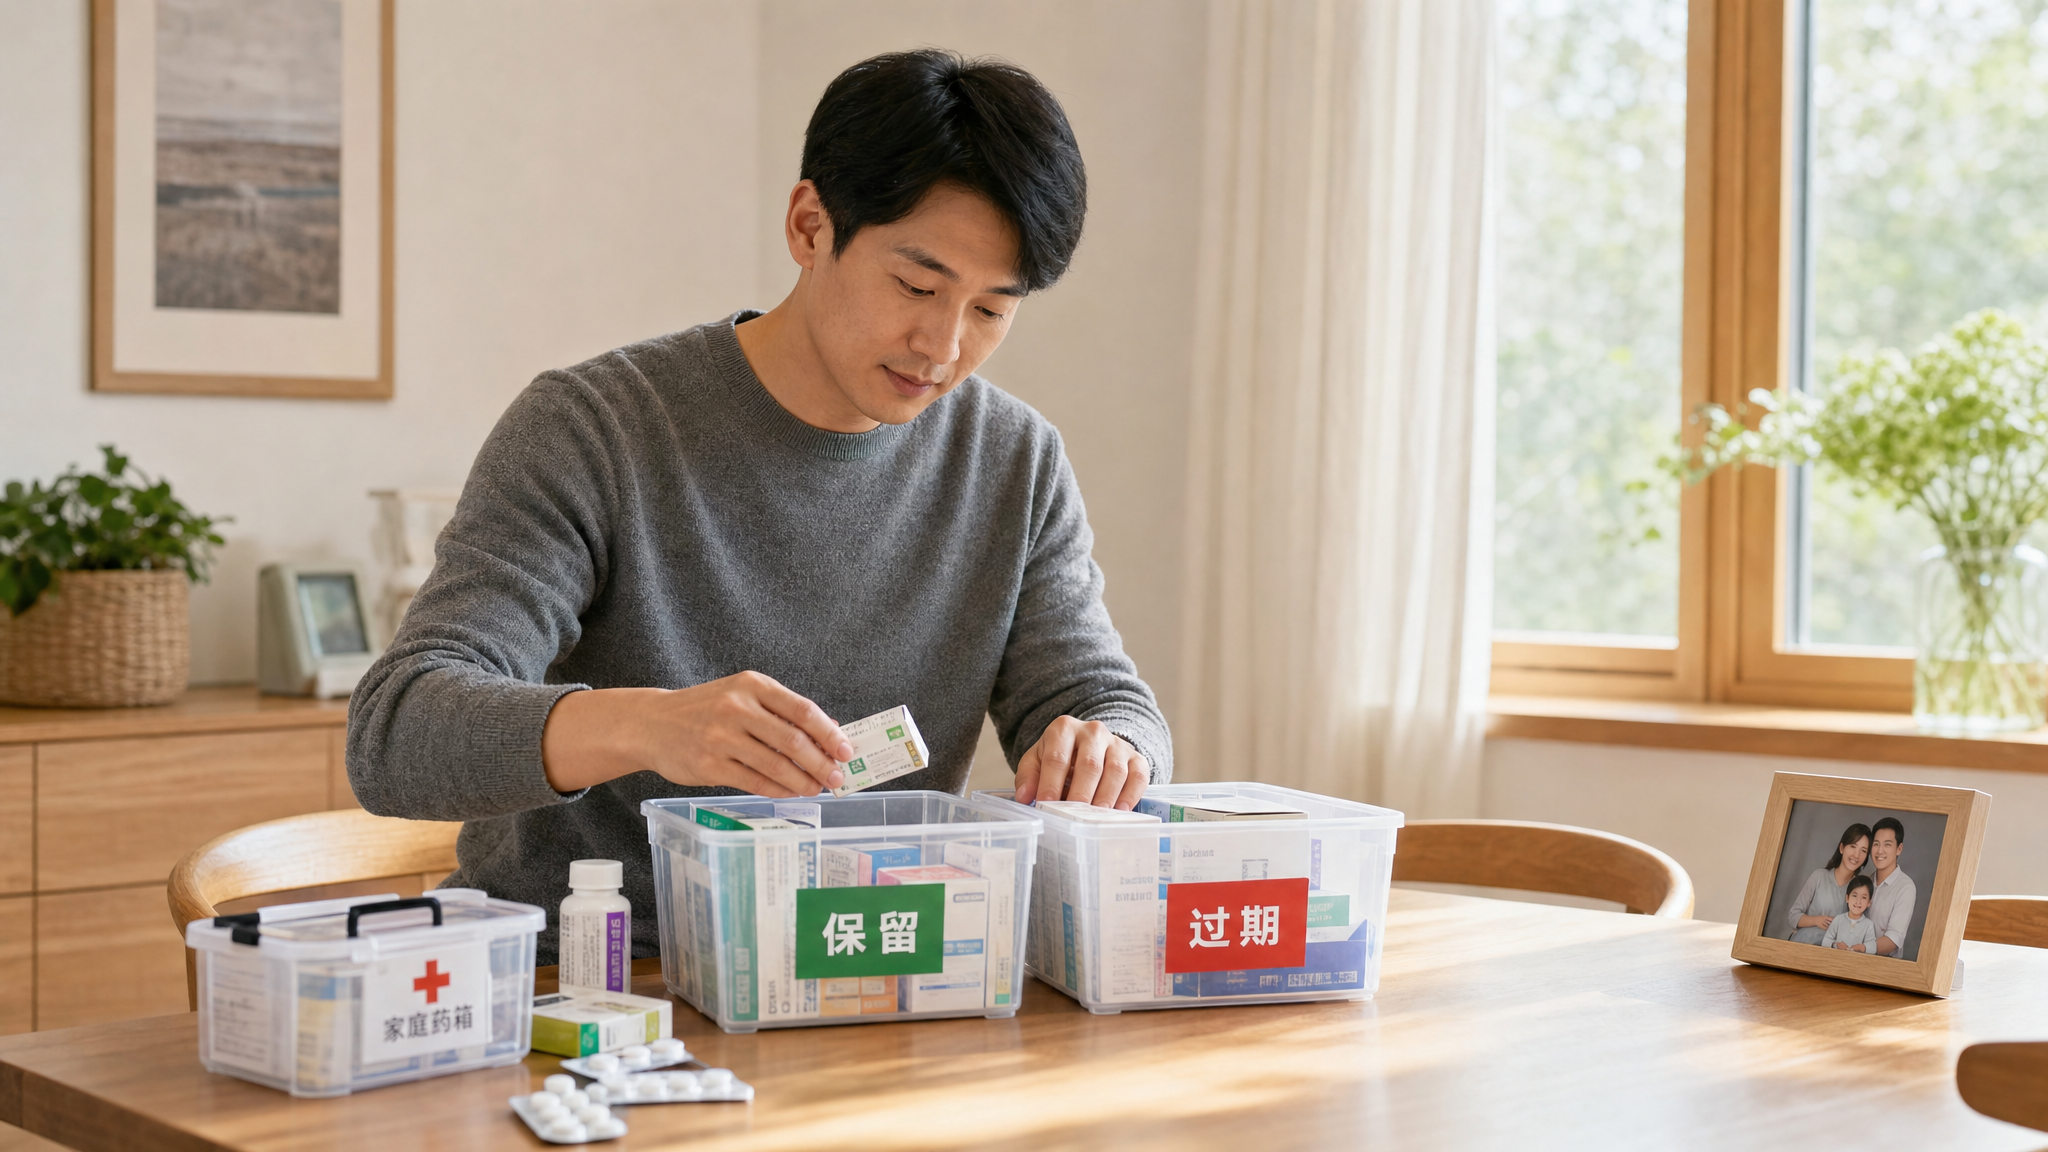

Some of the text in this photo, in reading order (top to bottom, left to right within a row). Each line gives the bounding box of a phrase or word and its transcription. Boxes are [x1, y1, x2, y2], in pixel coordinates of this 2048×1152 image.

[822, 911, 919, 956] 保留
[1189, 905, 1280, 949] 过期
[384, 1005, 473, 1043] 家庭药箱
